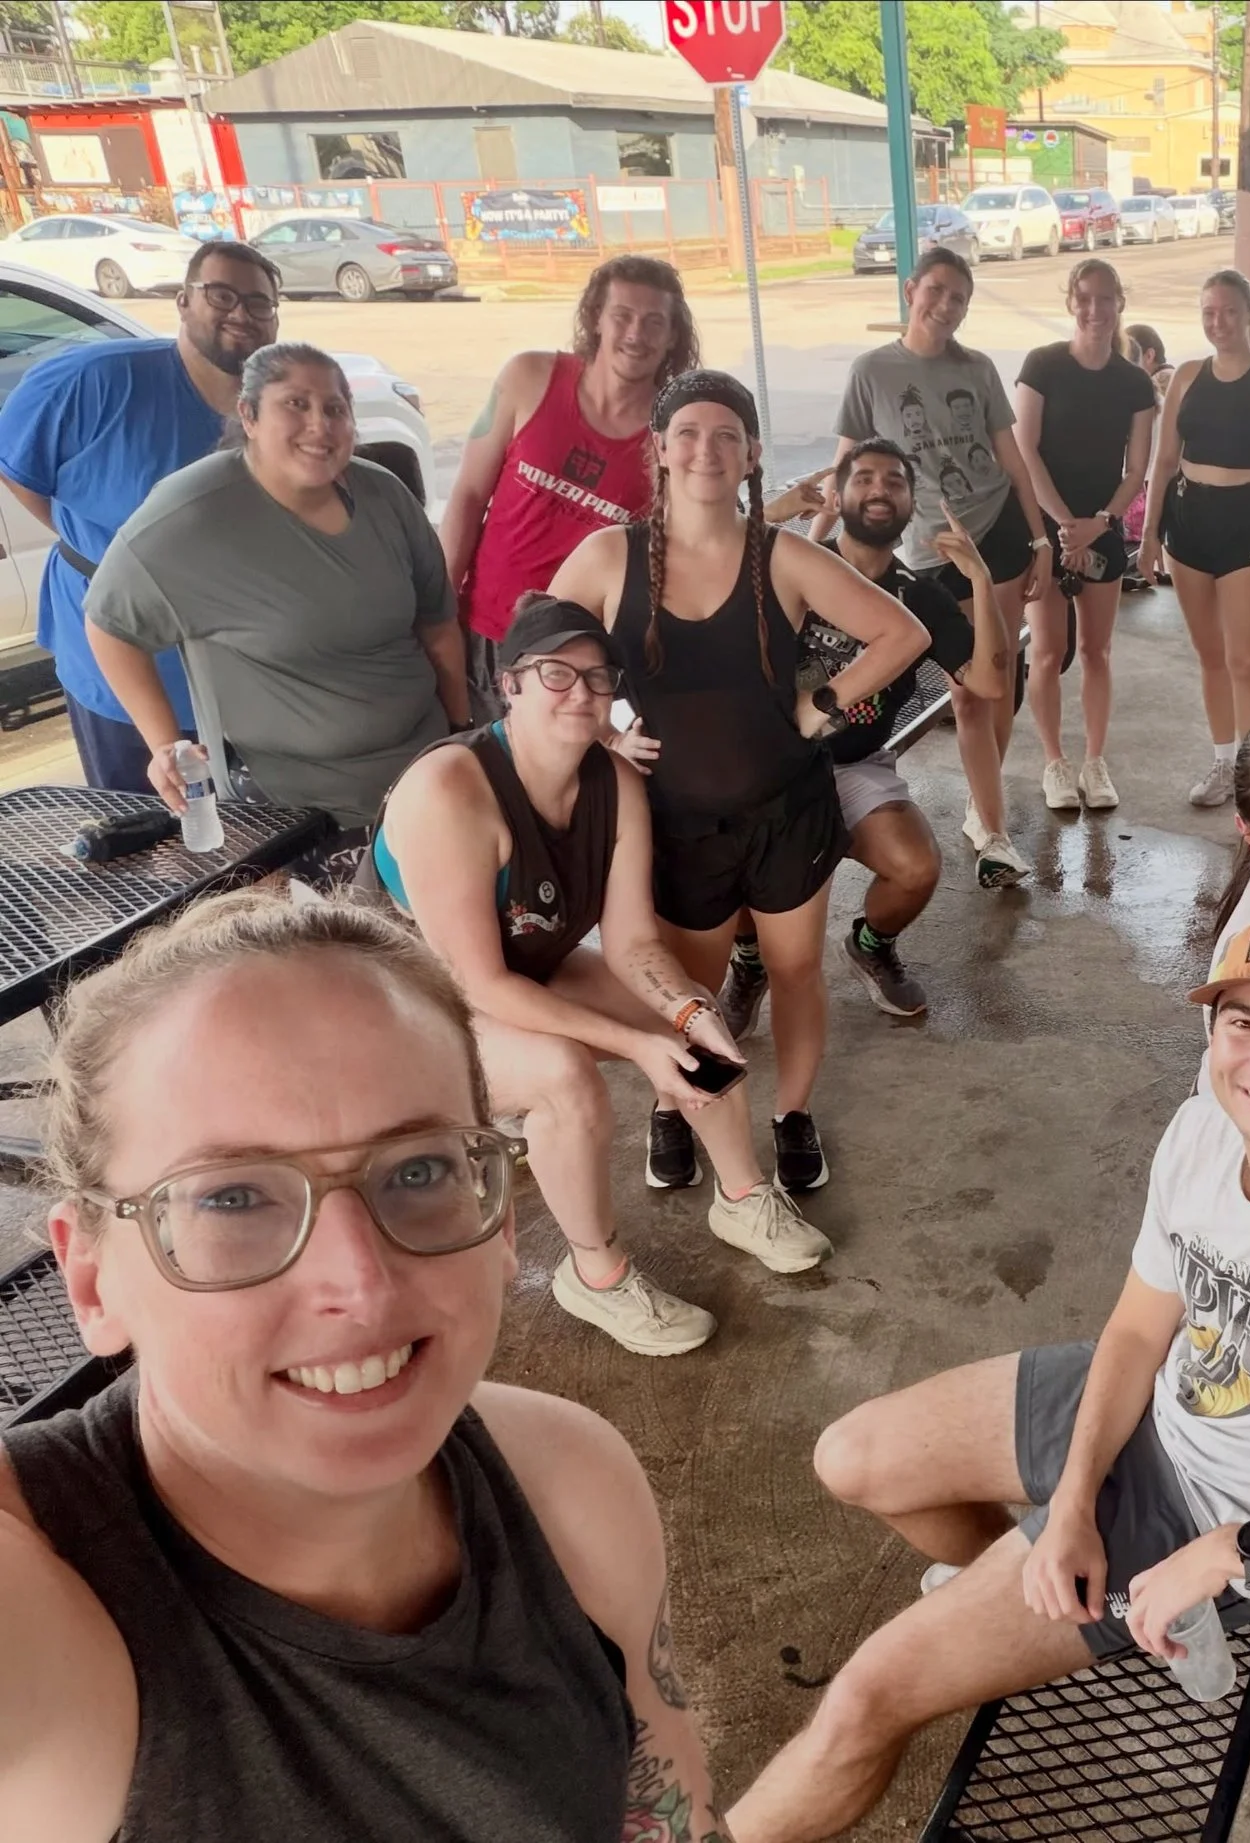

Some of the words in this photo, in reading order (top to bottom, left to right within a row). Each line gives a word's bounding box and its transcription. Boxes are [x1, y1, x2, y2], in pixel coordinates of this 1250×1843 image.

[517, 460, 585, 502] POWER
[580, 492, 631, 524] PARK
[1189, 1232, 1223, 1269] SAN
